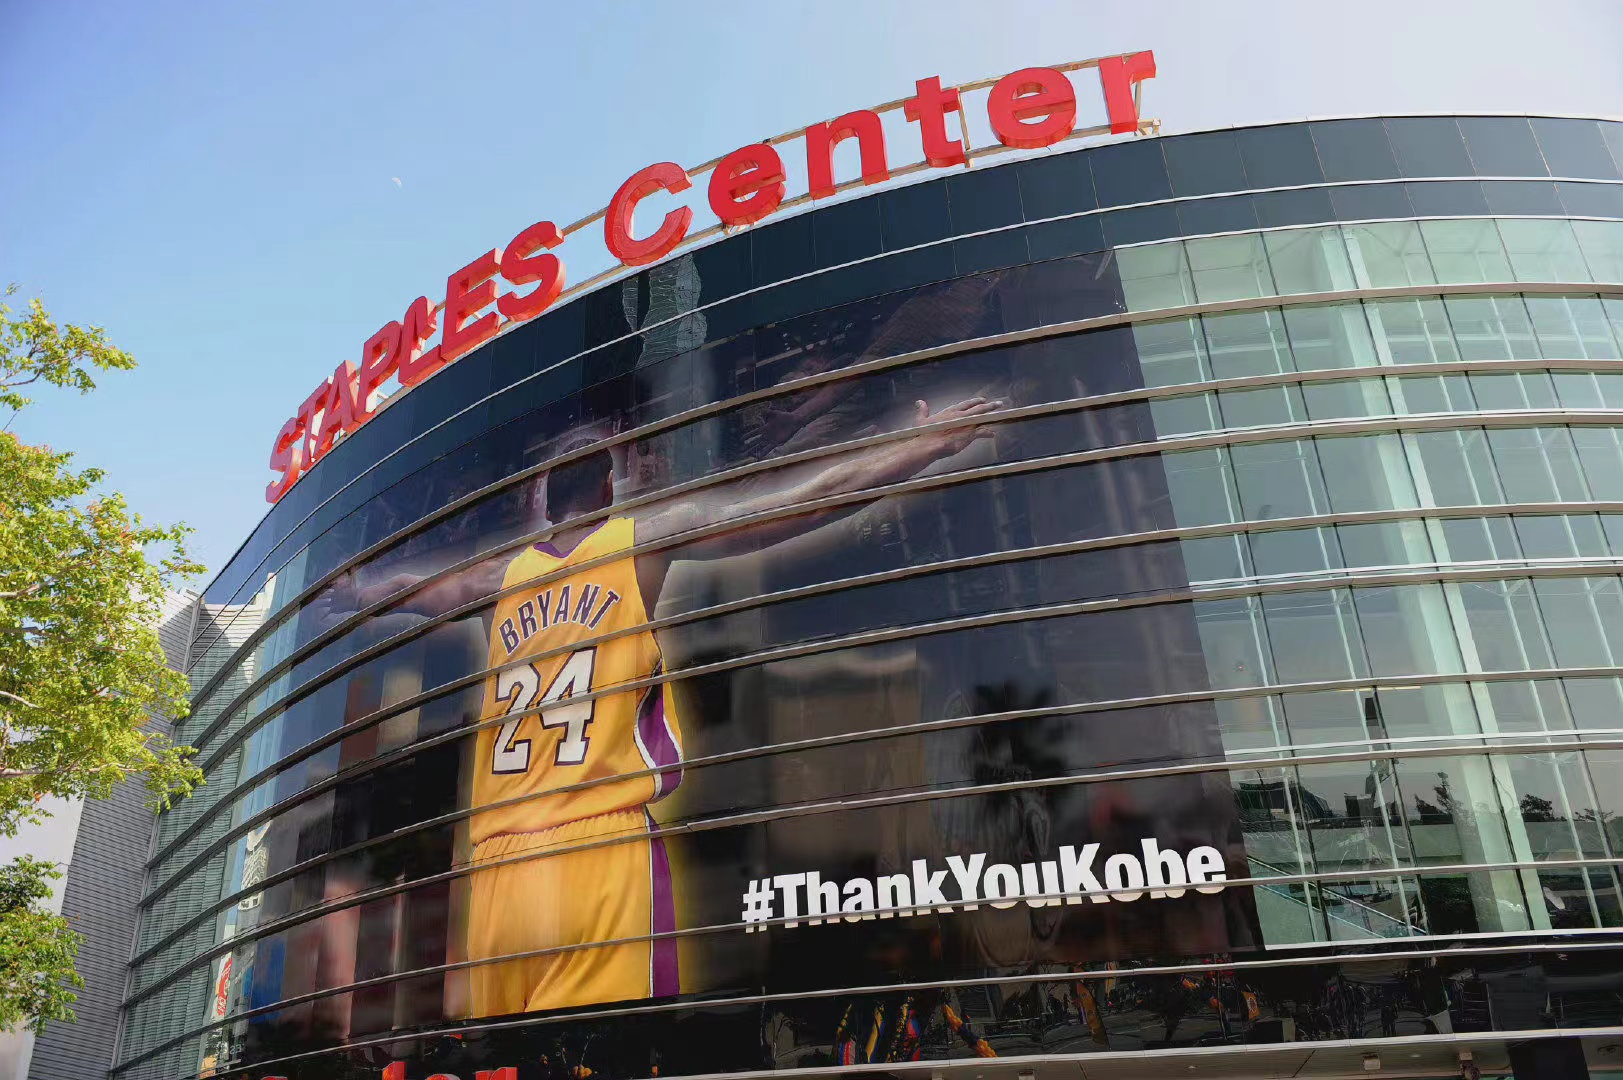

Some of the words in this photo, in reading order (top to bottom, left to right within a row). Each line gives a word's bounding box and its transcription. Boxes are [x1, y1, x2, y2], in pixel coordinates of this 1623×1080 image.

[266, 221, 566, 503] STAPLES
[604, 50, 1156, 267] Center
[498, 582, 621, 656] BRYANT
[491, 645, 598, 775] 24
[741, 837, 1227, 933] #ThankYouKobe
